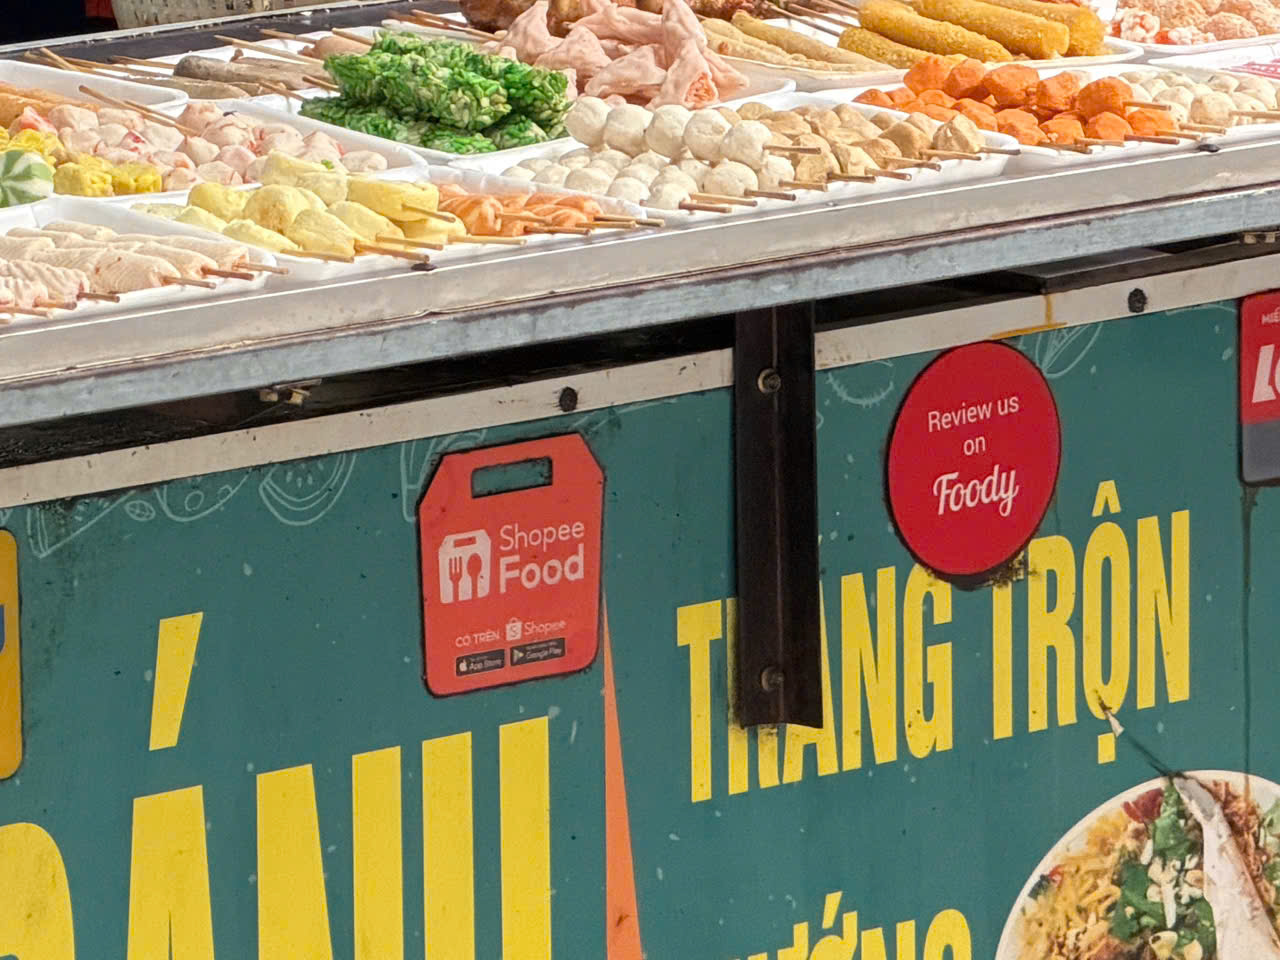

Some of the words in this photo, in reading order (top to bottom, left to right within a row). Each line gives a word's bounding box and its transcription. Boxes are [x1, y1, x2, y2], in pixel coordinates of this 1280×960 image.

[927, 401, 992, 433] Review
[997, 396, 1020, 415] us
[963, 436, 986, 455] on
[932, 464, 1020, 517] Foody
[499, 520, 585, 552] Shopee
[499, 543, 584, 594] Food
[524, 620, 567, 636] Shopee
